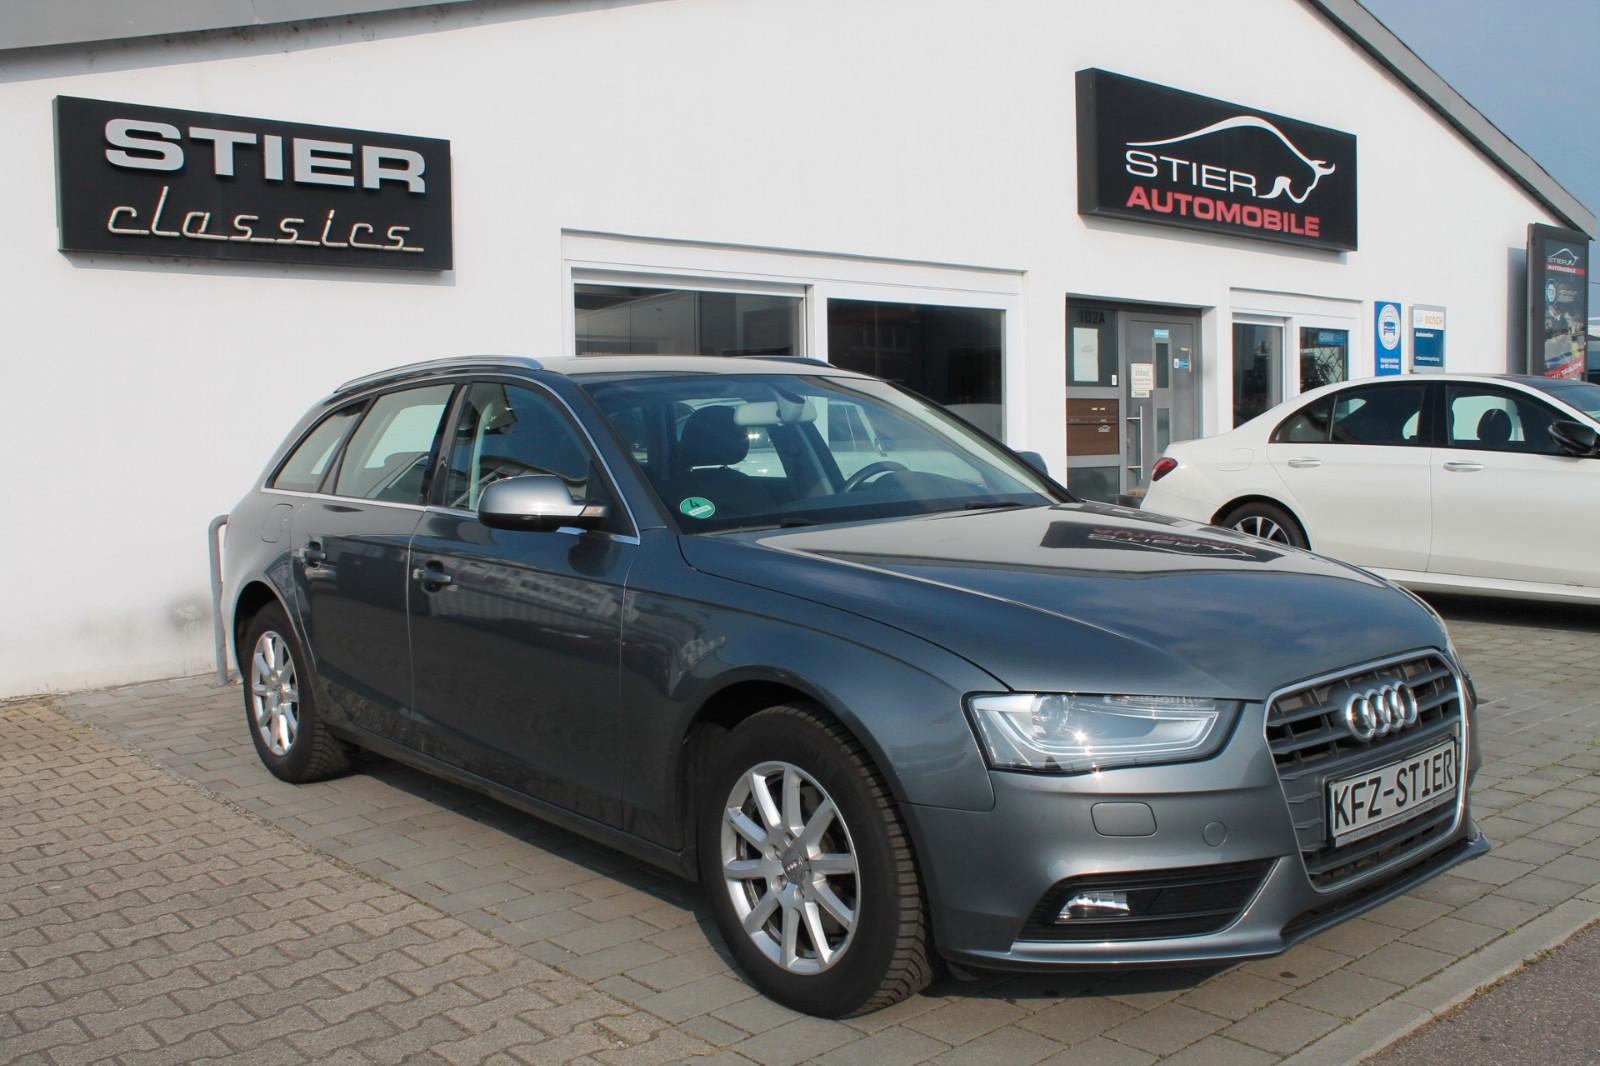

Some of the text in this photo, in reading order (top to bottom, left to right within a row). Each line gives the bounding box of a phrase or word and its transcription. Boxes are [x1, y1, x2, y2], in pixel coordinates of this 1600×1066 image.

[105, 118, 426, 194] STIER
[1125, 150, 1257, 197] STIER
[107, 186, 425, 252] classics
[1126, 185, 1320, 237] AUTOMOBILE
[1080, 310, 1105, 323] 102A
[1333, 748, 1454, 829] KFZ-STIER
